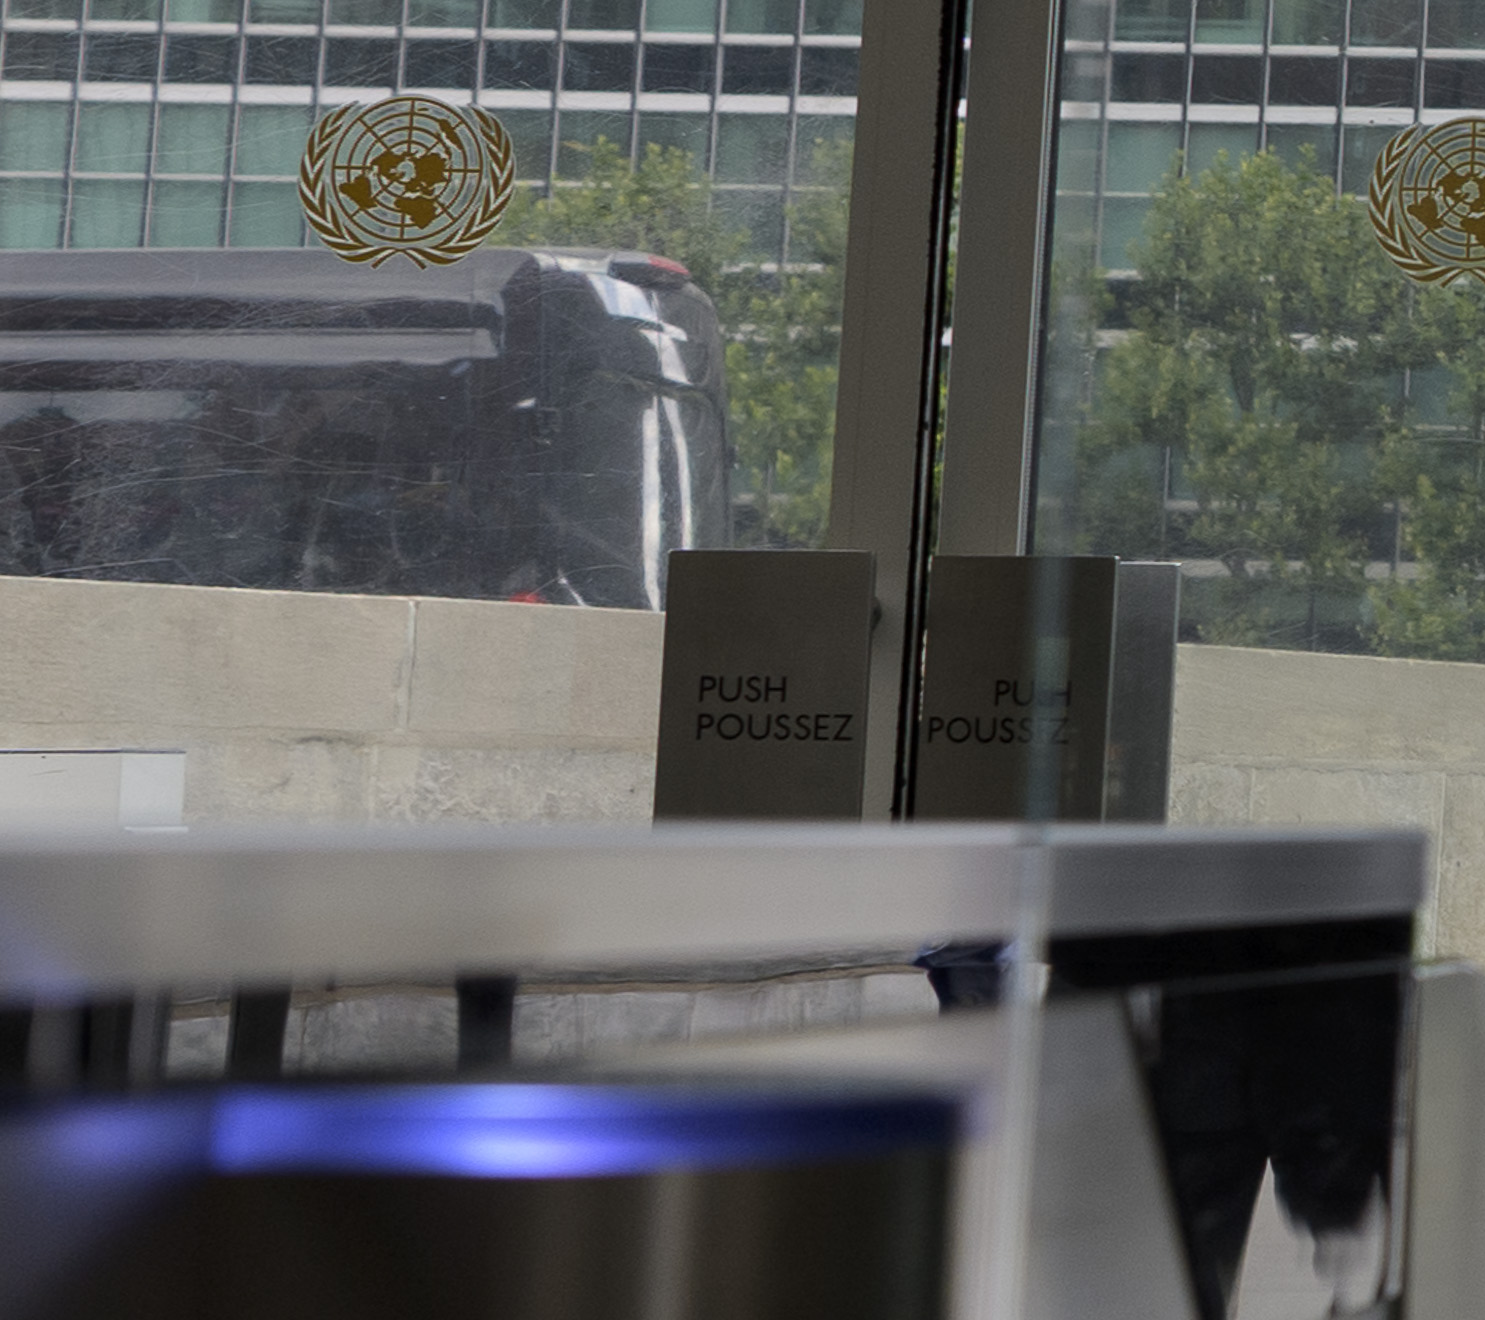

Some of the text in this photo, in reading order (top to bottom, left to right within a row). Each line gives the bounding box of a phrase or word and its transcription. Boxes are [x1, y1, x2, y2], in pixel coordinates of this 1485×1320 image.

[697, 675, 788, 703] PUSH
[993, 678, 1073, 708] PUH
[695, 712, 854, 741] POUSSEZ
